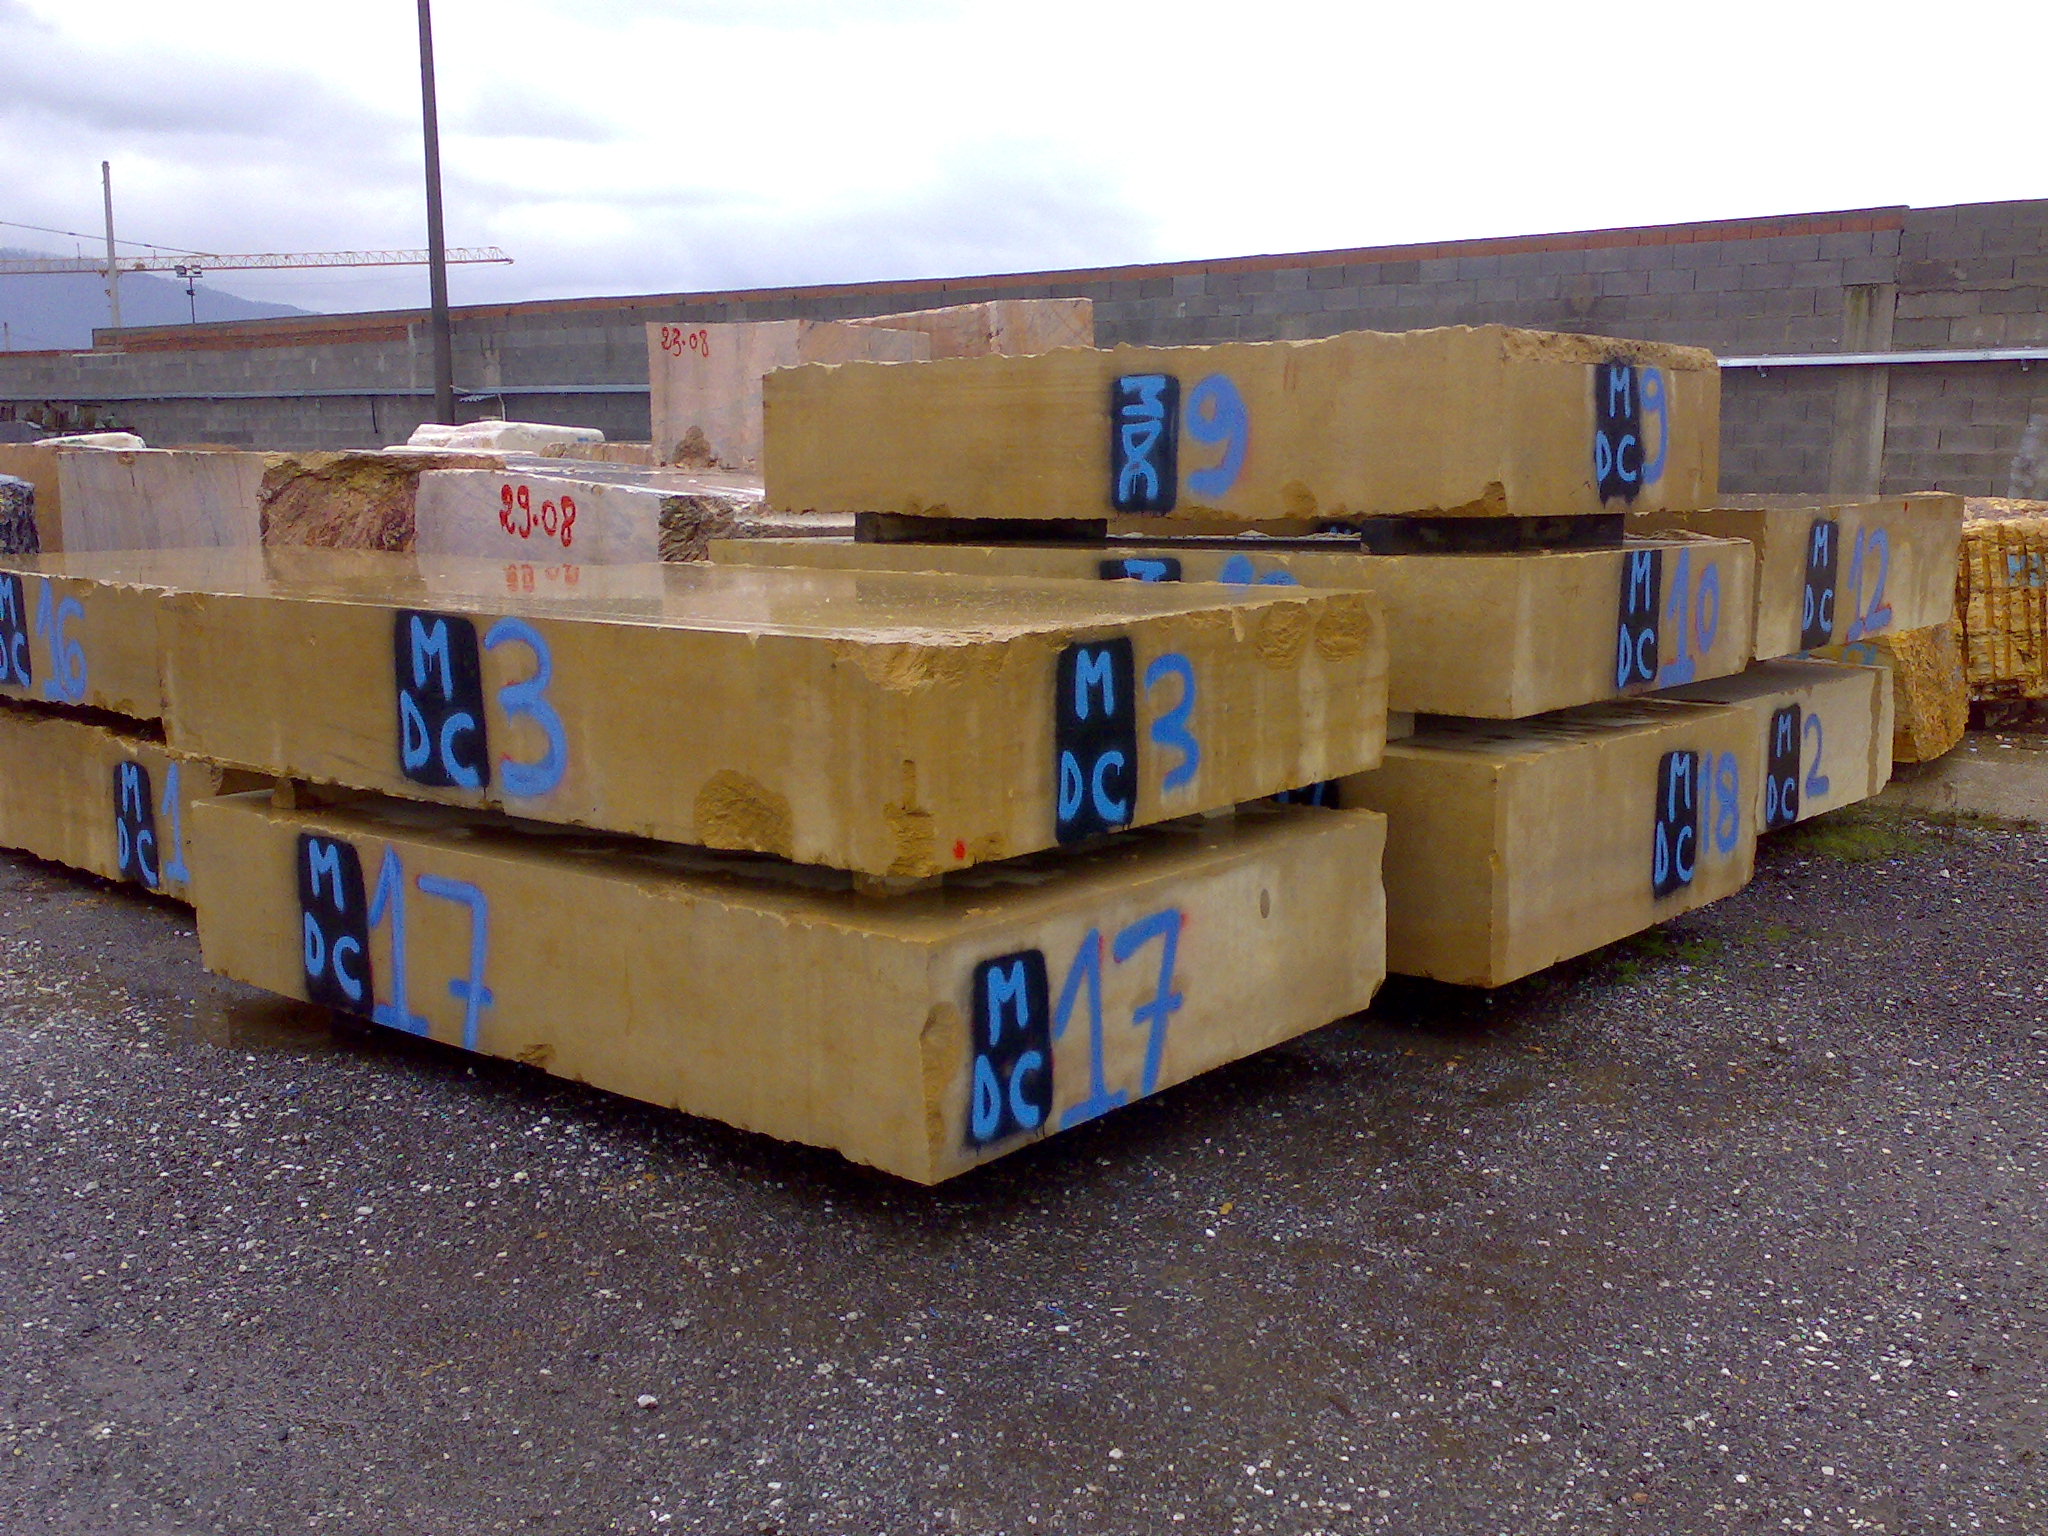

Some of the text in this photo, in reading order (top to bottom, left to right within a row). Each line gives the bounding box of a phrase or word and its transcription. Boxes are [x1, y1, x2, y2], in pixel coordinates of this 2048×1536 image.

[1609, 366, 1631, 418] M
[1640, 366, 1668, 485] 9
[1186, 373, 1249, 497] 9
[1595, 430, 1637, 483] DC
[499, 484, 576, 547] 29.08
[1812, 524, 1829, 567] M
[1629, 550, 1651, 614] M
[1660, 547, 1720, 688] 10
[1802, 585, 1833, 632] DC
[1847, 526, 1892, 643] 12
[36, 577, 88, 702] 16
[410, 615, 454, 700] M
[1617, 623, 1655, 689] DC
[484, 616, 567, 796] 3
[1075, 648, 1114, 720] M
[1144, 652, 1199, 791] 3
[401, 689, 484, 788] DC
[1776, 713, 1792, 758] M
[1804, 713, 1829, 798] 2
[121, 762, 142, 823] M
[1058, 749, 1126, 823] DC
[1668, 752, 1690, 822] M
[1698, 751, 1740, 854] 18
[1767, 774, 1795, 823] DC
[117, 816, 158, 887] DC
[308, 838, 345, 912] M
[1654, 820, 1694, 885] DC
[304, 911, 362, 1000] DC
[369, 844, 493, 1049] 17
[988, 960, 1028, 1047] M
[1054, 907, 1184, 1130] 17
[972, 1050, 1042, 1140] DC
